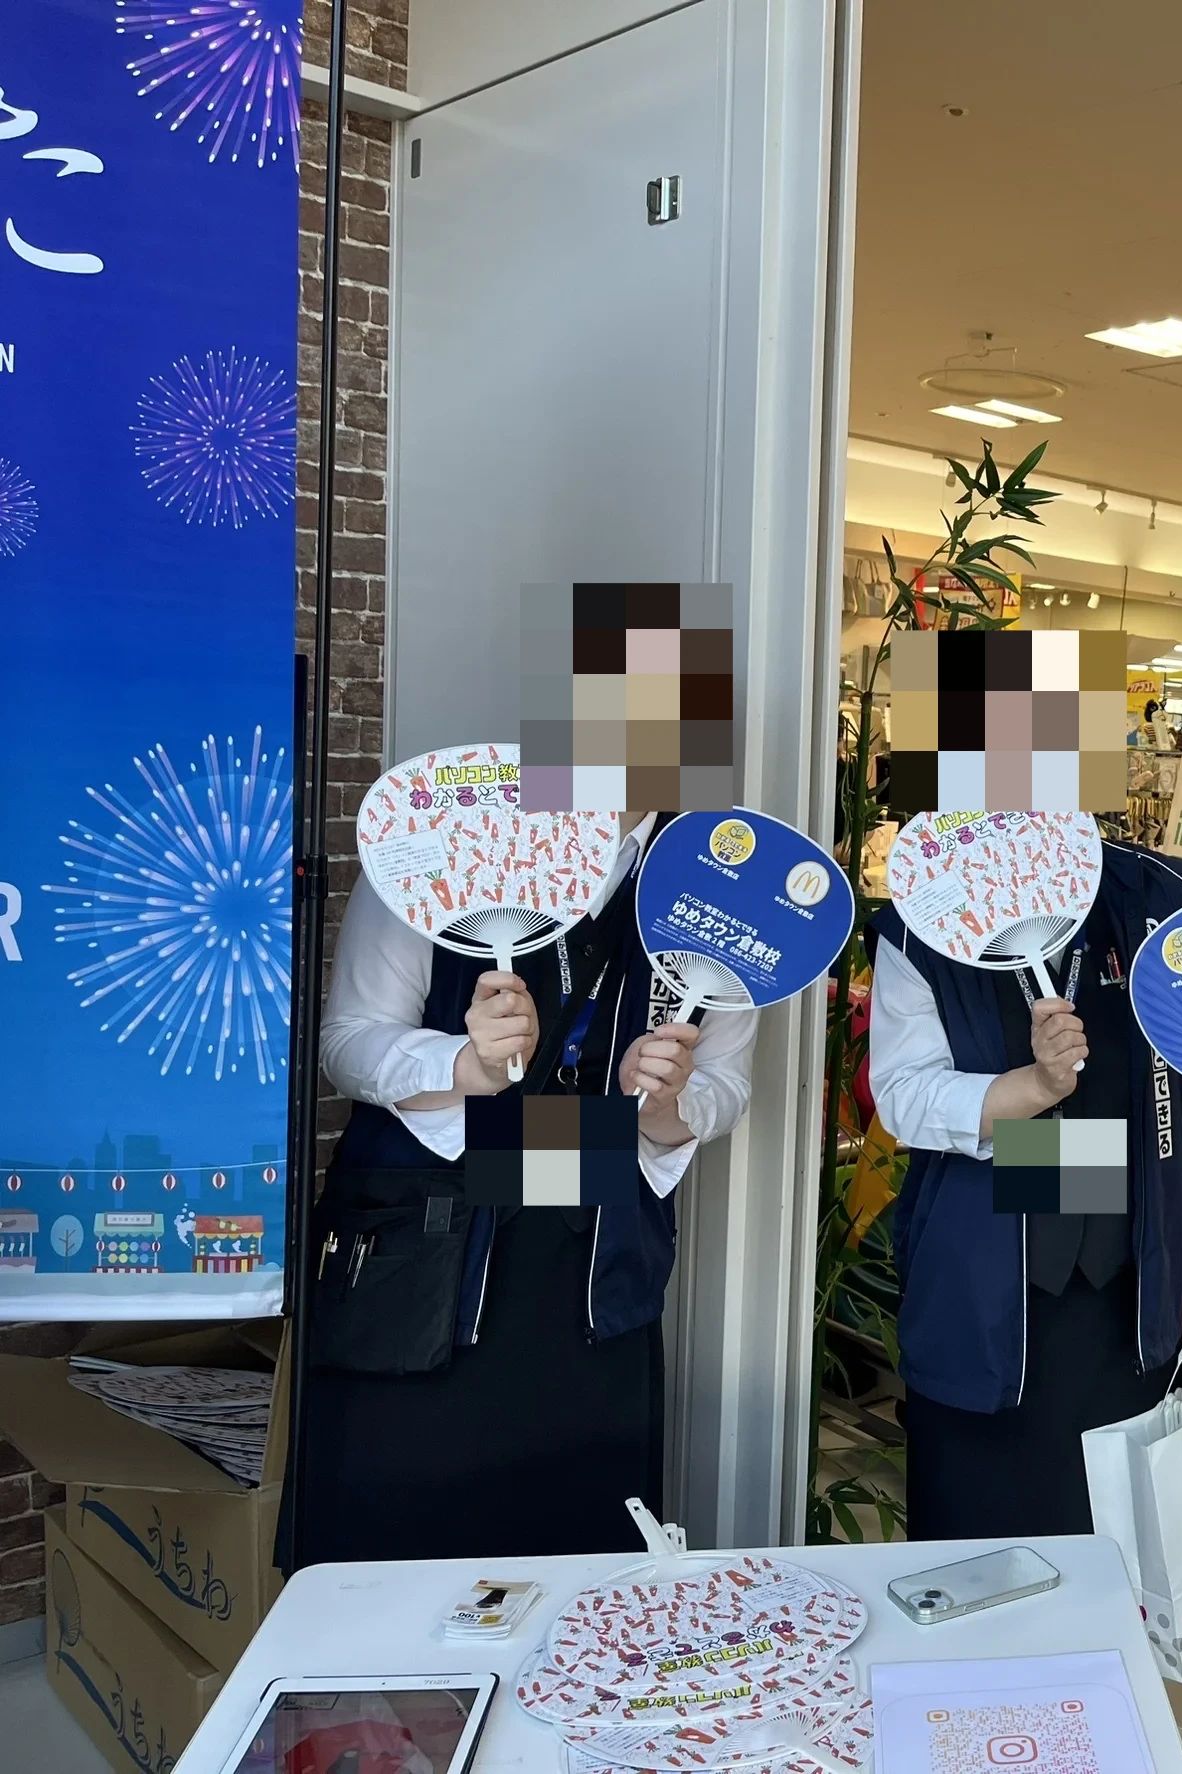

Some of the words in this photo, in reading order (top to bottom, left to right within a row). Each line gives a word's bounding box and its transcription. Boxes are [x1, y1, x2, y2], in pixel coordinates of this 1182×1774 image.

[672, 900, 781, 965] ゆめタウン倉敷校
